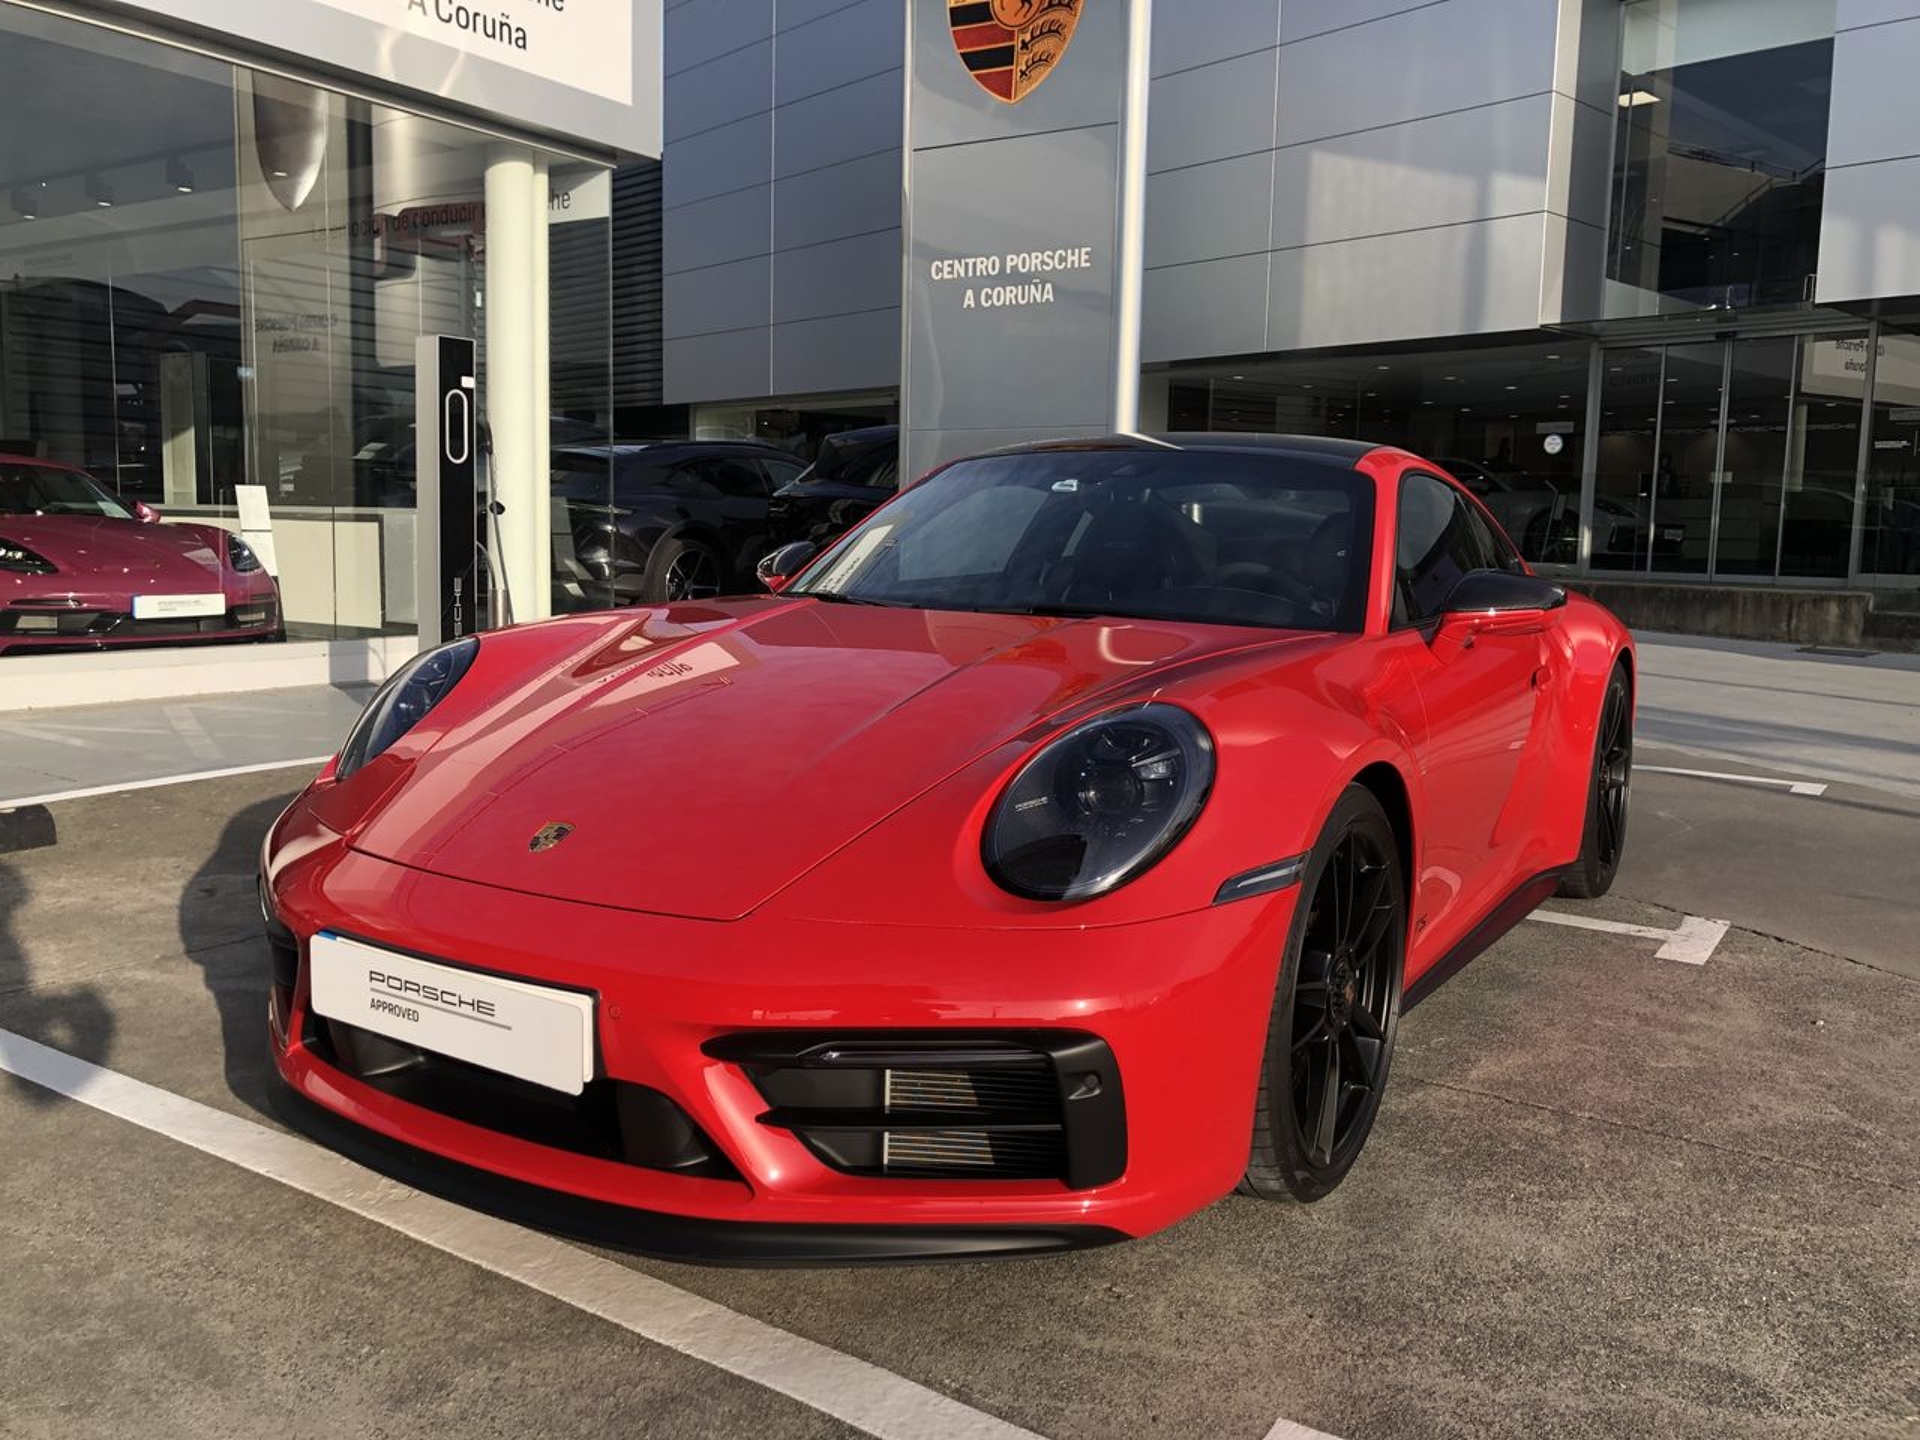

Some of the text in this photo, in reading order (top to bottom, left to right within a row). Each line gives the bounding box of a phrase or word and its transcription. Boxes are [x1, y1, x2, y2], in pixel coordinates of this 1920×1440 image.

[435, 0, 527, 50] Coruña
[931, 246, 1092, 280] CENTRO PORSCHE
[963, 278, 1054, 309] A CORUÑA
[369, 970, 495, 1017] PORSCHE
[370, 998, 420, 1023] APPROVED
